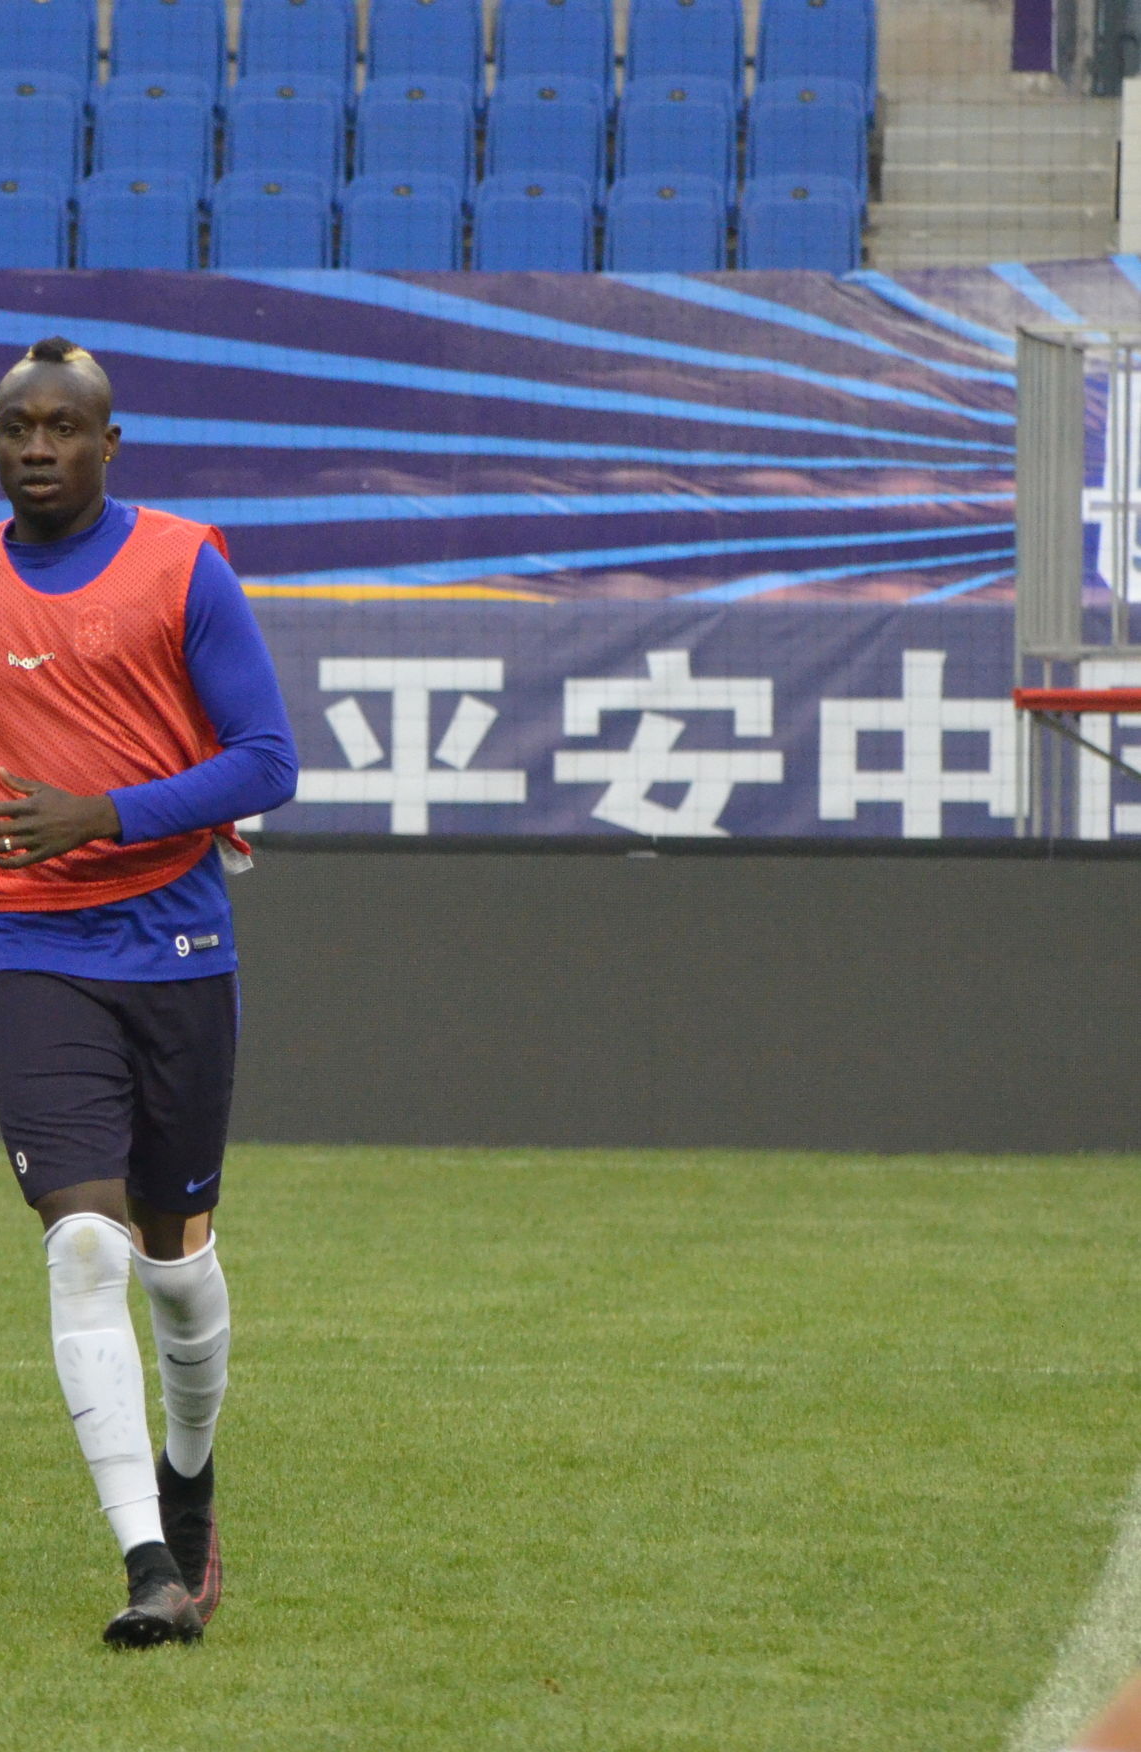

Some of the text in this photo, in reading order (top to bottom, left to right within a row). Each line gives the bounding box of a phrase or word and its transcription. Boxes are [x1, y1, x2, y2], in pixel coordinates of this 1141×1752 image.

[296, 649, 1141, 841] 平安中
[175, 935, 190, 957] 9
[16, 1151, 28, 1174] 9
